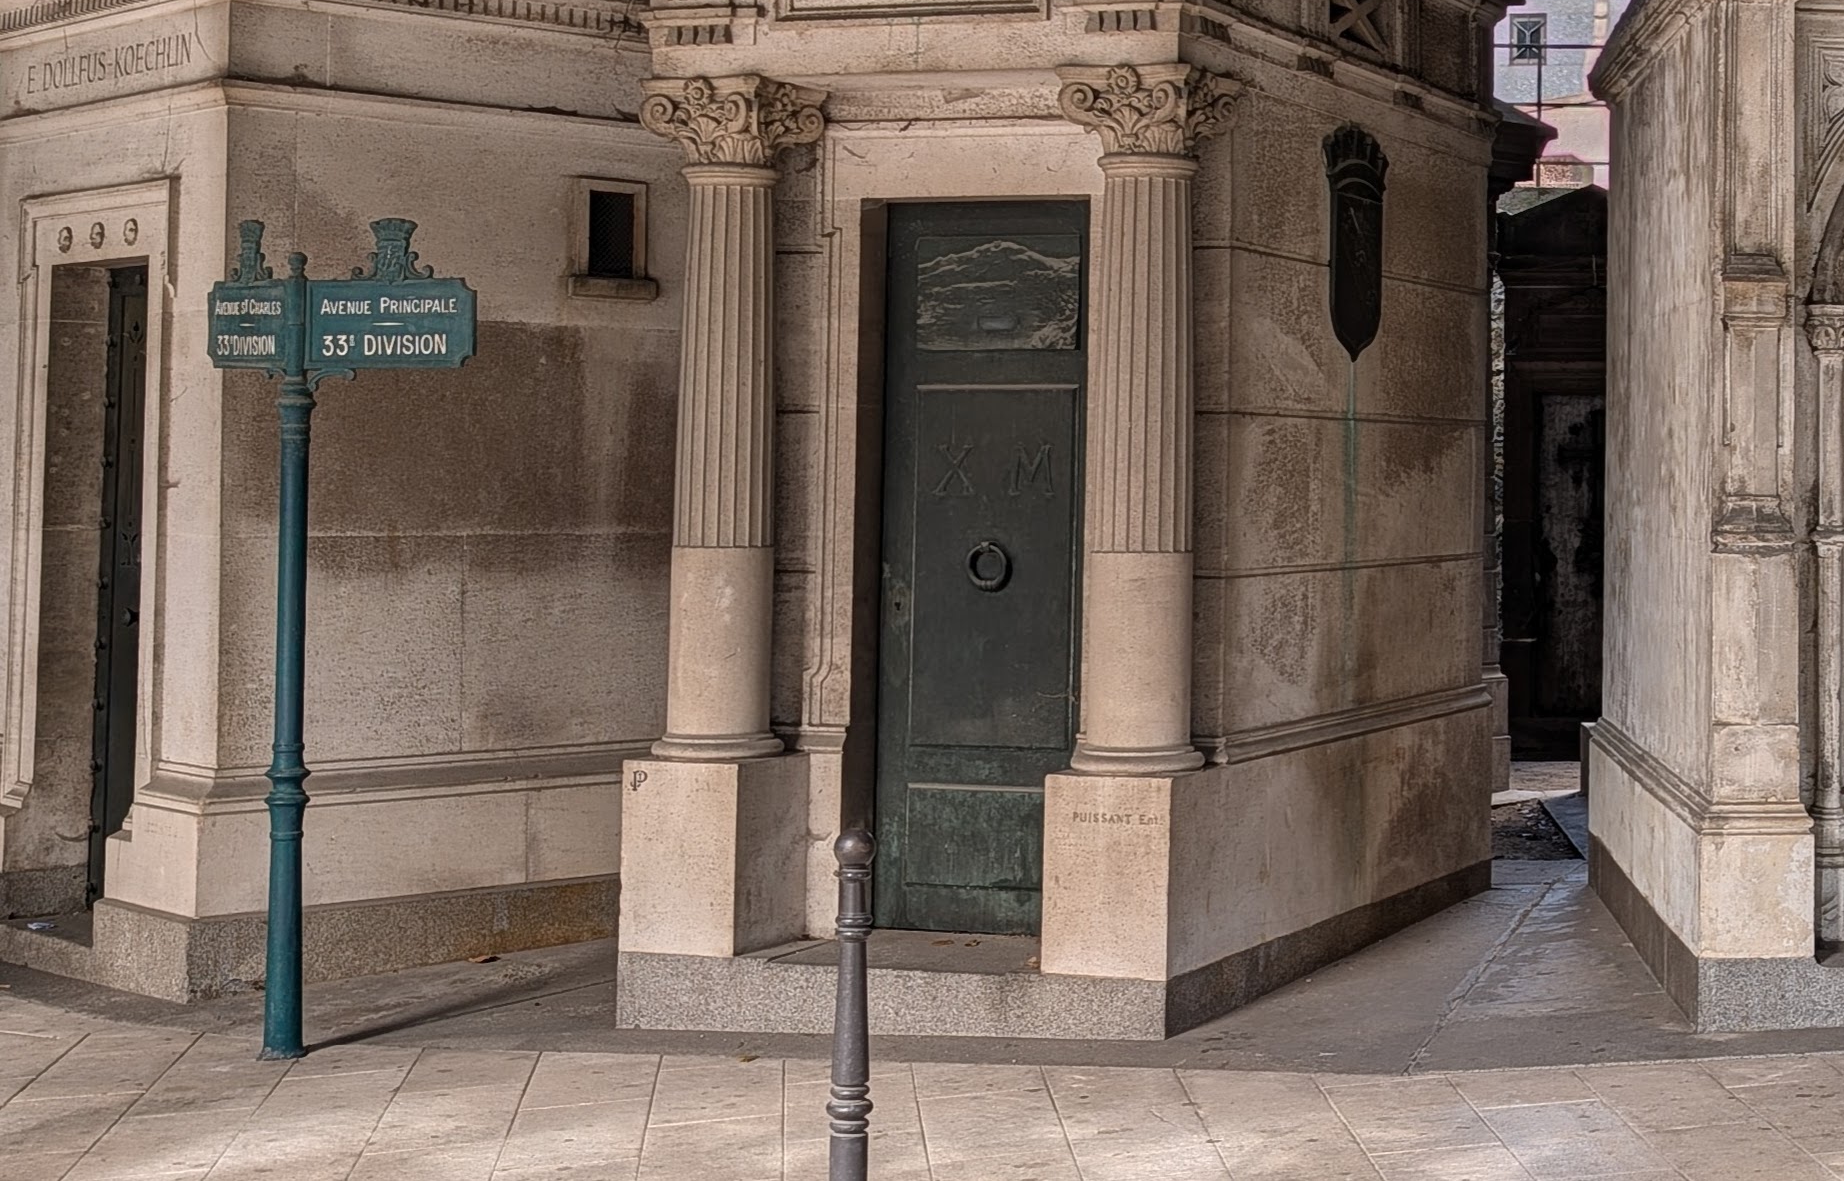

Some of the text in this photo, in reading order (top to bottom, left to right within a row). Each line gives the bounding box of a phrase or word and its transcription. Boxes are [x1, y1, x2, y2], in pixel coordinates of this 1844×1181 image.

[42, 31, 192, 92] DOLLFUS-KOECHLIN
[215, 299, 240, 316] AVENUE
[249, 299, 282, 316] CHARLES
[320, 296, 458, 315] AVENUE PRINCIPALE
[233, 334, 276, 356] DIVISION
[363, 334, 447, 356] DIVISION
[1072, 811, 1132, 825] PUISSANT
